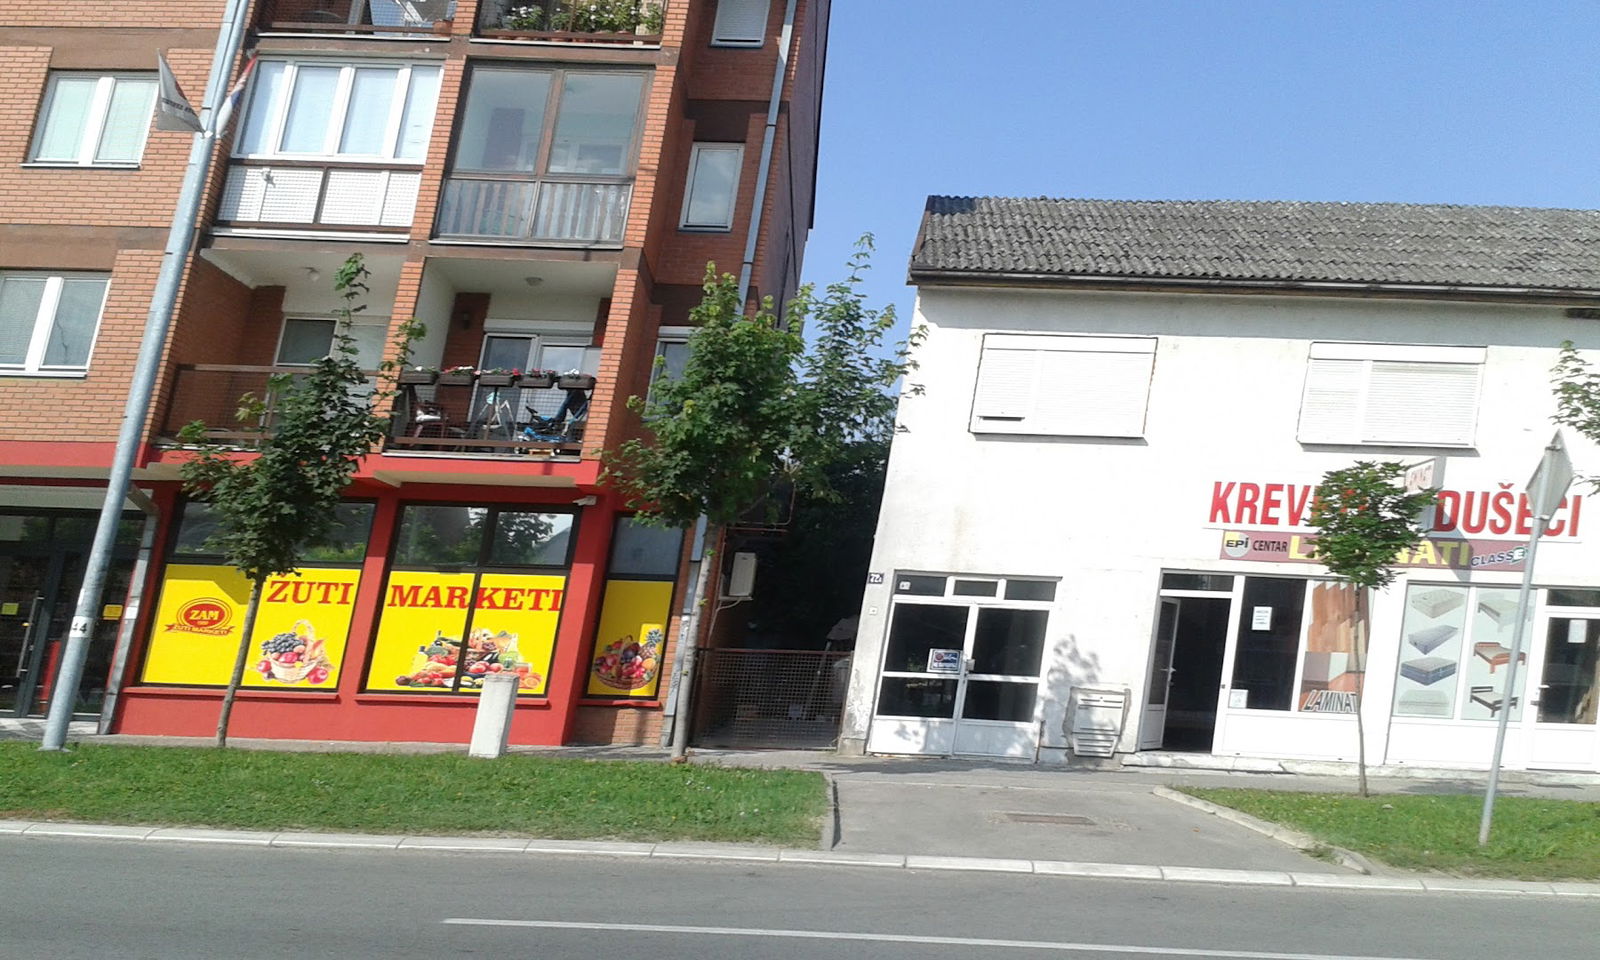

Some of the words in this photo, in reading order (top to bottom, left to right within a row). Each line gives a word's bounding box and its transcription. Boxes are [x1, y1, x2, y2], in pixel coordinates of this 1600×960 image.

[1209, 481, 1364, 528] KREV
[1252, 540, 1288, 553] CENTAR
[266, 573, 354, 604] ŽUTI
[387, 585, 563, 611] MARKETI
[189, 609, 219, 620] ZAM
